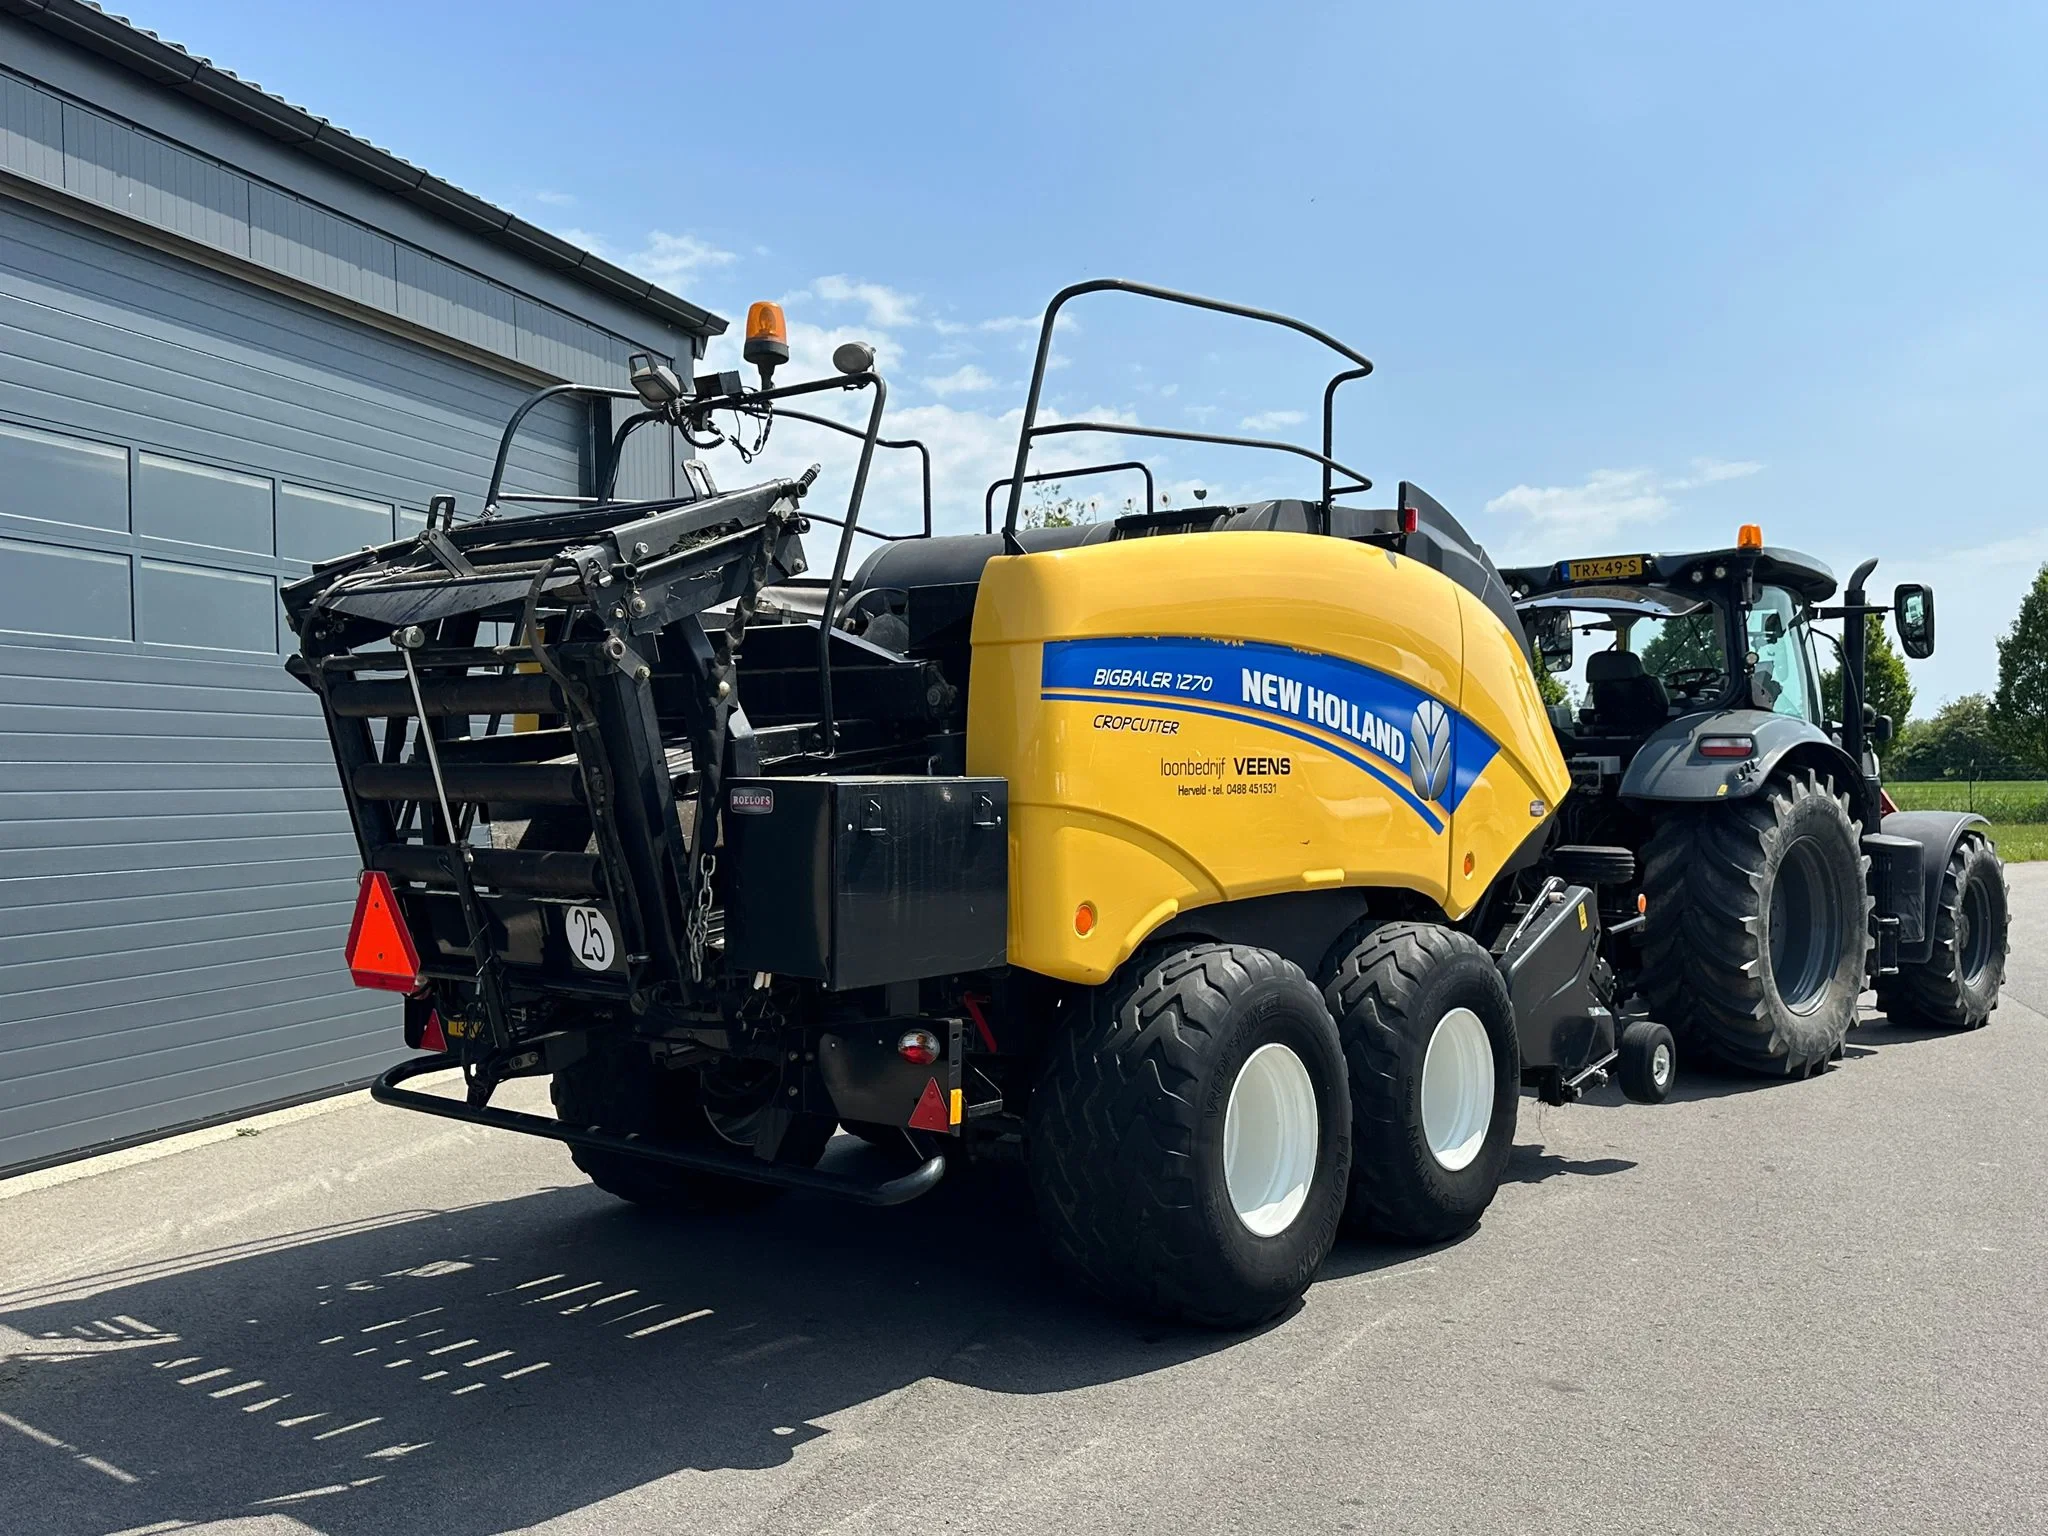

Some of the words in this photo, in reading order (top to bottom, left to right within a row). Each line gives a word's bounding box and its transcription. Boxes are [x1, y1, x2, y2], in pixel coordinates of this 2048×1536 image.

[1573, 559, 1637, 577] TRX-49-S
[1093, 669, 1173, 689] BIGBALER
[1175, 673, 1214, 692] 1270
[1093, 714, 1180, 735] CROPCUTTER
[1241, 667, 1303, 715] NEW
[1307, 685, 1406, 764] HOLLAND
[1160, 757, 1226, 780] loonbedrijf
[1233, 757, 1291, 775] VEENS
[732, 795, 771, 805] ROELOFS
[1178, 785, 1206, 796] Herveld
[1212, 785, 1224, 795] tel.
[1226, 783, 1247, 795] 0488
[1248, 783, 1277, 794] 451531
[574, 909, 606, 962] 25
